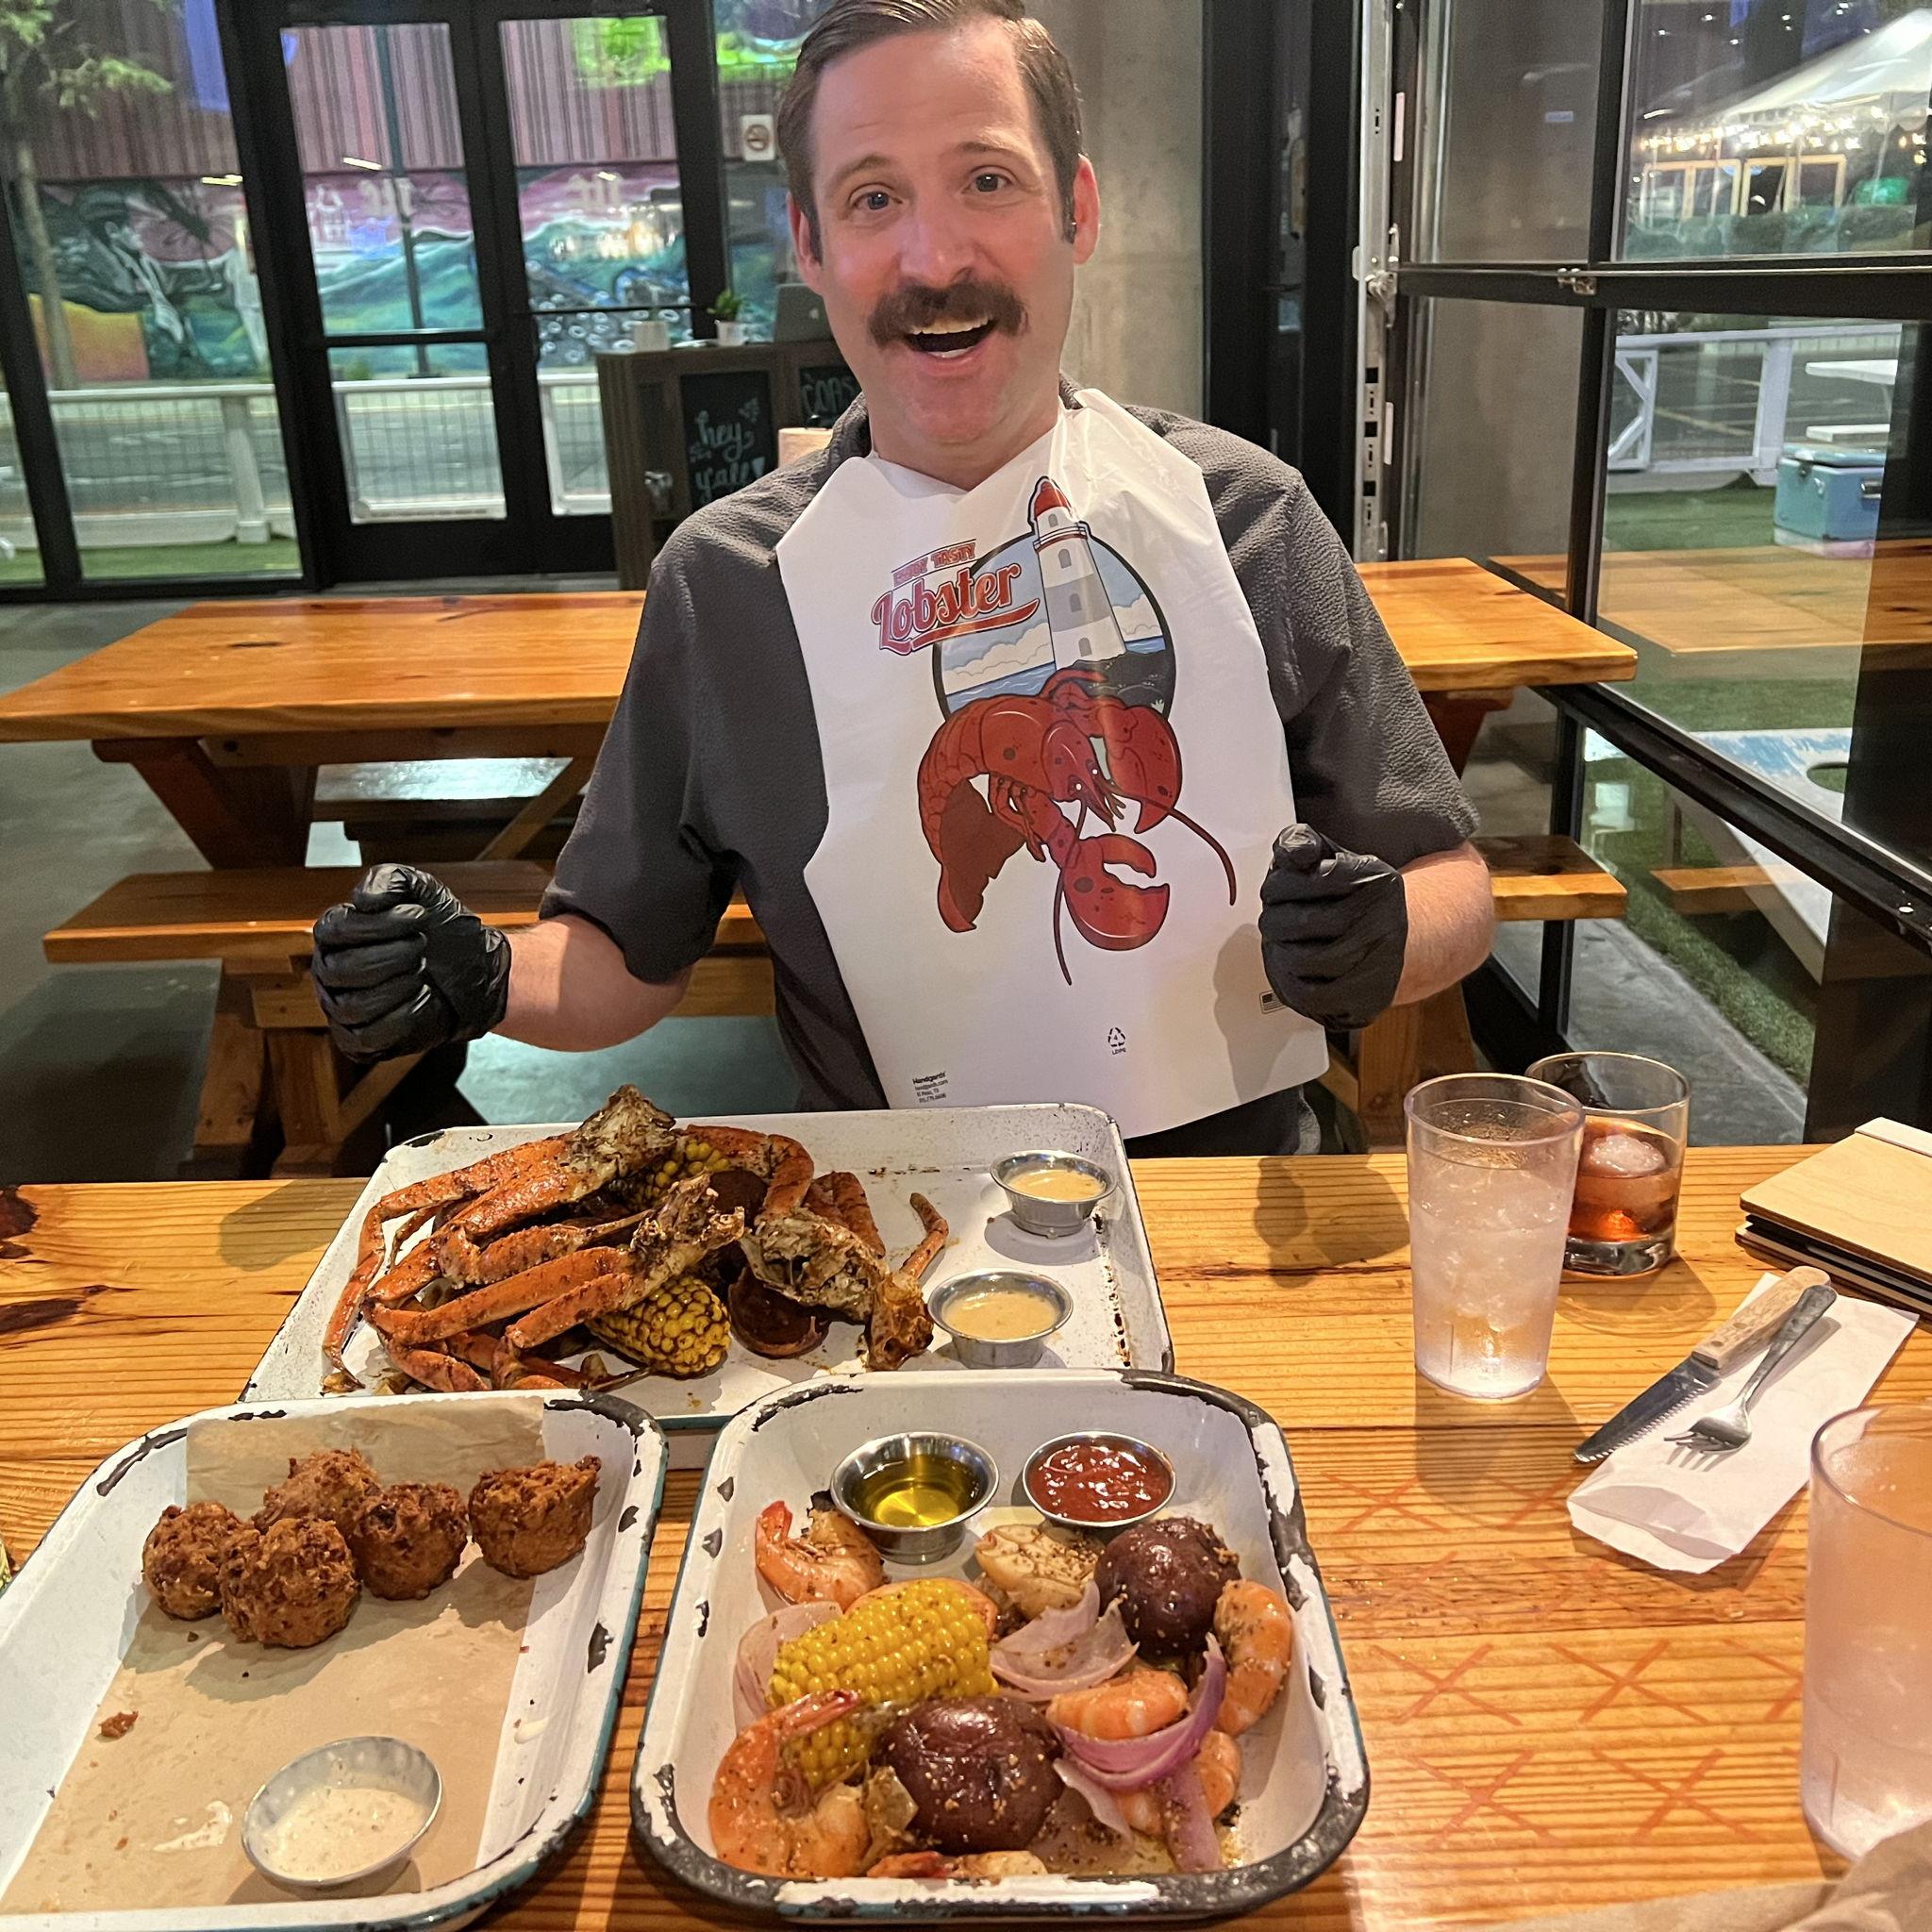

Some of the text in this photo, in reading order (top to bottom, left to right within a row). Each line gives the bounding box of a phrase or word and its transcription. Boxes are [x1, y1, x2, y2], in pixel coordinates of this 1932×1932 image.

[695, 409, 742, 462] hey
[930, 542, 975, 568] TASTY
[871, 563, 1022, 656] Lobster
